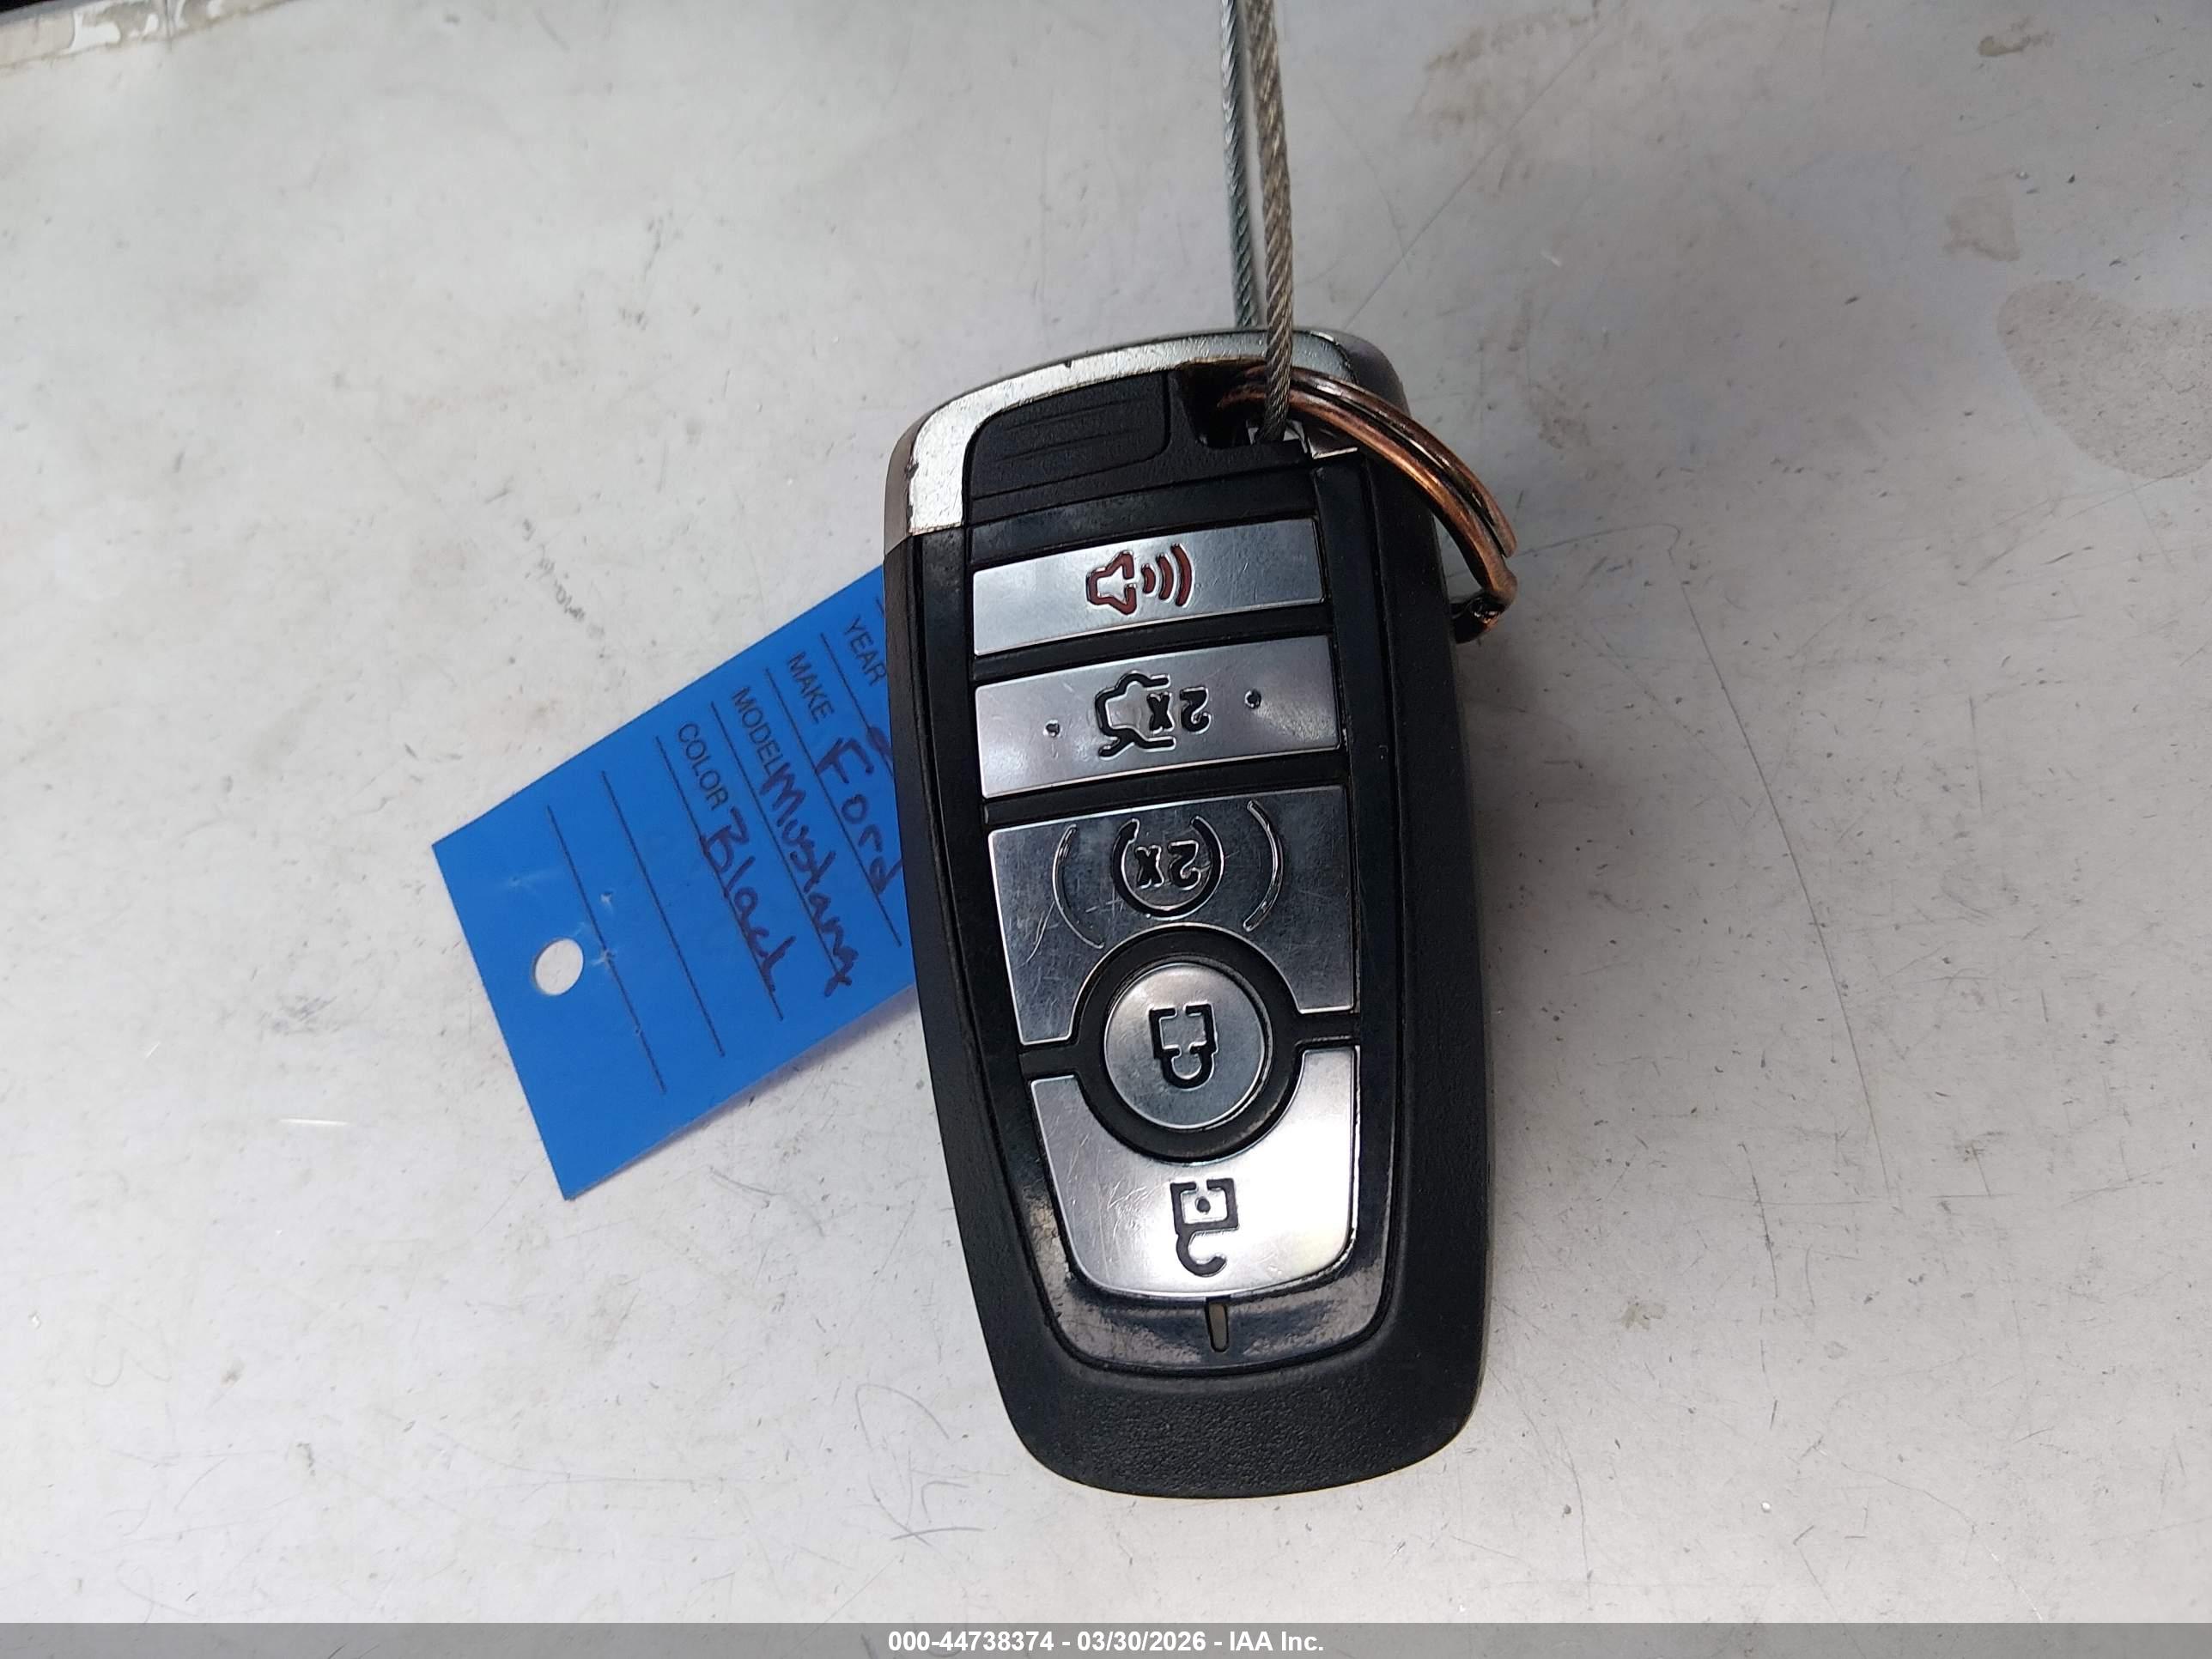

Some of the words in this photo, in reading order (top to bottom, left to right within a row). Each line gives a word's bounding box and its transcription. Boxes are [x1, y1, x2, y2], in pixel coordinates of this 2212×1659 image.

[787, 651, 835, 723] MAKE
[844, 615, 887, 687] YEAR
[678, 724, 726, 811] COLOR
[732, 686, 782, 779] MODEL
[816, 733, 903, 896] Ford
[761, 770, 859, 996] Mustang
